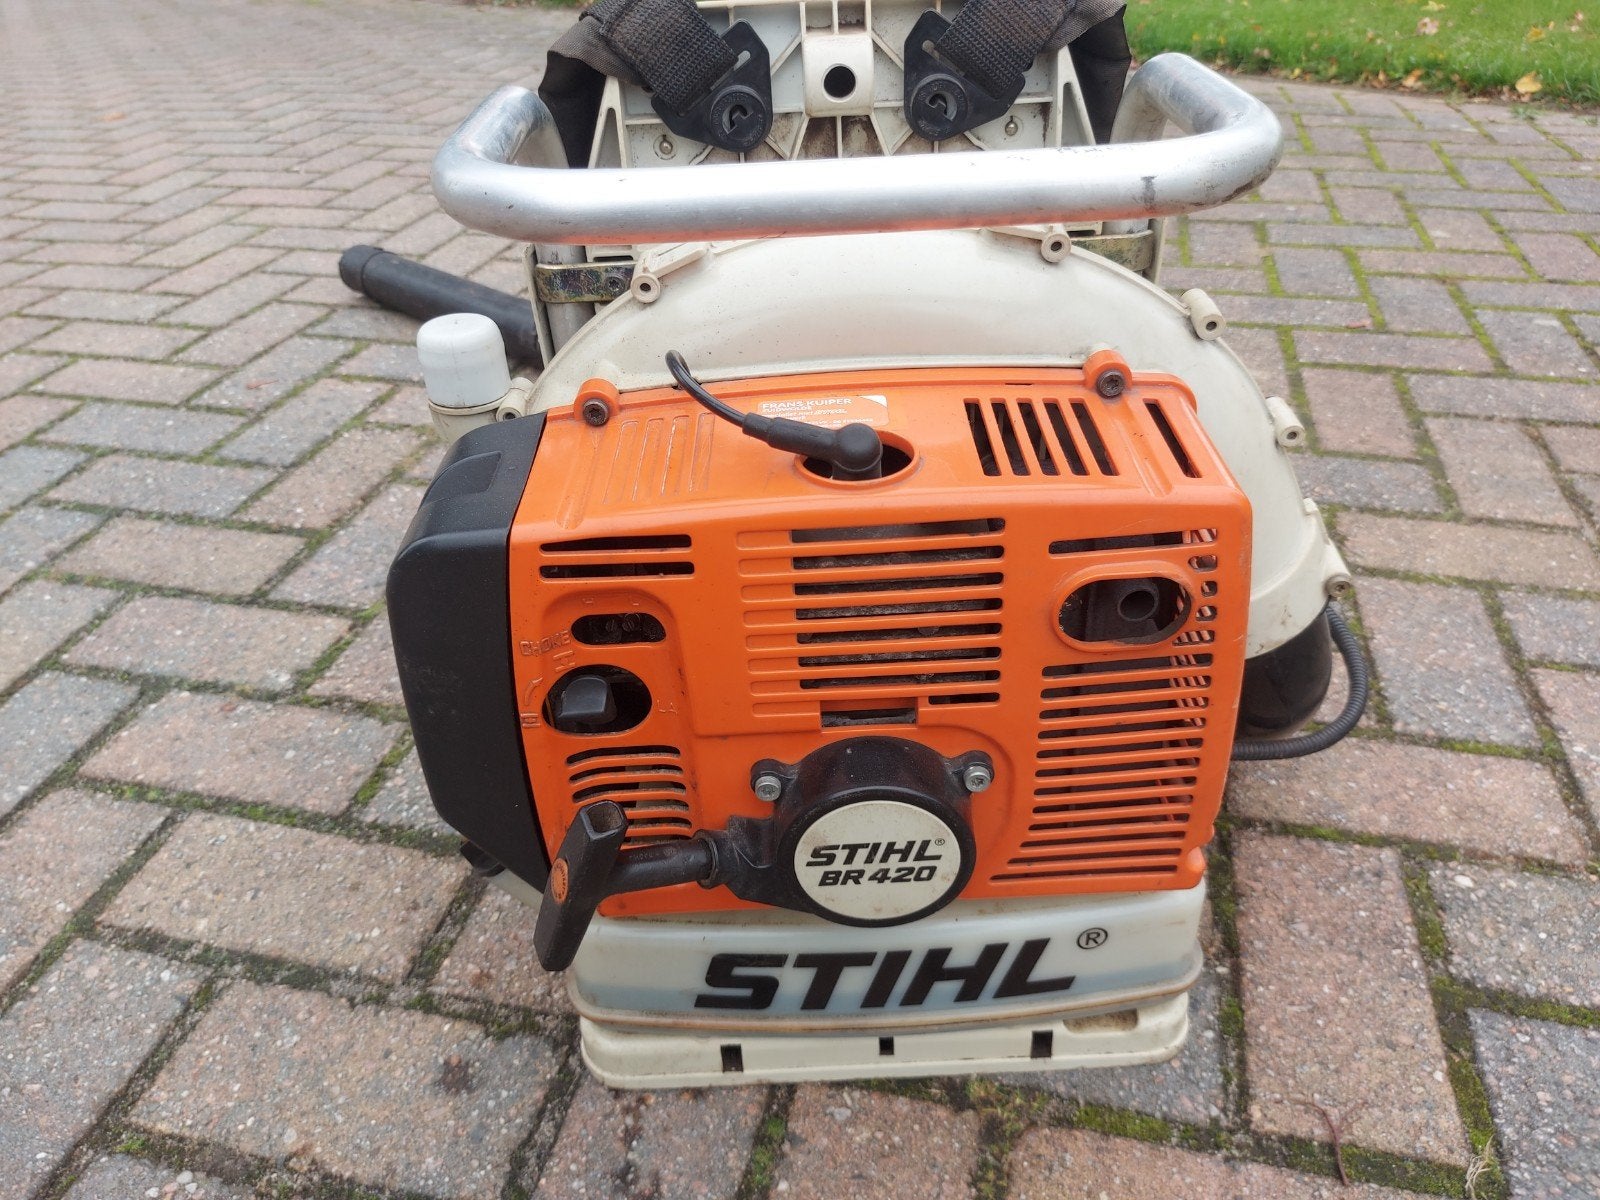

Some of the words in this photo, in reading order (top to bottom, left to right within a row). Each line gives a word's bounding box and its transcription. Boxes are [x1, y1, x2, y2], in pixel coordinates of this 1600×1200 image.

[762, 401, 803, 410] FRANS
[806, 398, 852, 406] KUIPER
[519, 630, 571, 657] CHOKE
[805, 839, 943, 867] STIHL
[818, 869, 866, 887] BR
[867, 865, 938, 884] 420
[694, 937, 1077, 1010] STIHL
